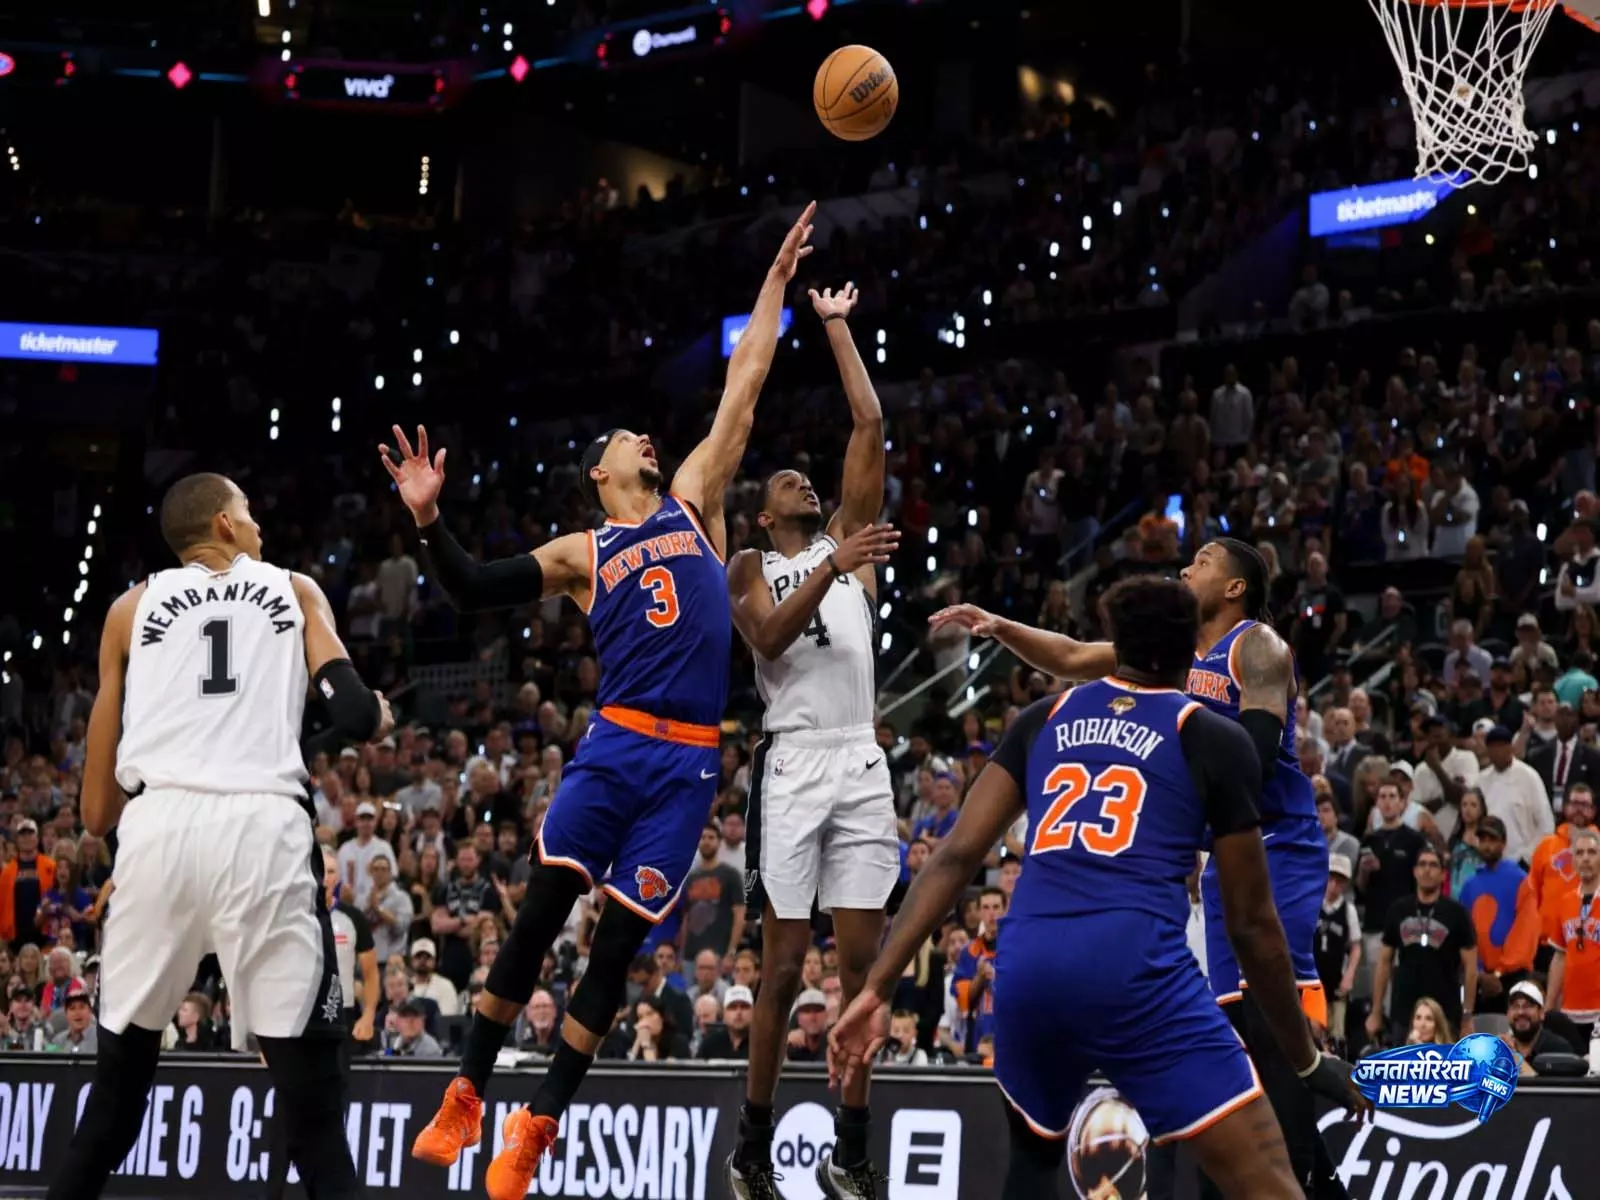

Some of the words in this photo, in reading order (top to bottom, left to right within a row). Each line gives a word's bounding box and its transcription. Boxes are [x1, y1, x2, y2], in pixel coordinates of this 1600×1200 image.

[20, 332, 118, 355] ticketmaster
[598, 541, 644, 594] NEW
[641, 531, 702, 562] YORK
[141, 581, 296, 646] WEMBANYAMA
[640, 565, 680, 627] 3
[804, 606, 830, 648] 4
[199, 616, 241, 698] 1
[1055, 718, 1165, 761] ROBINSON
[1029, 763, 1147, 857] 23
[178, 1085, 203, 1179] 6
[492, 1101, 719, 1200] CESSARY
